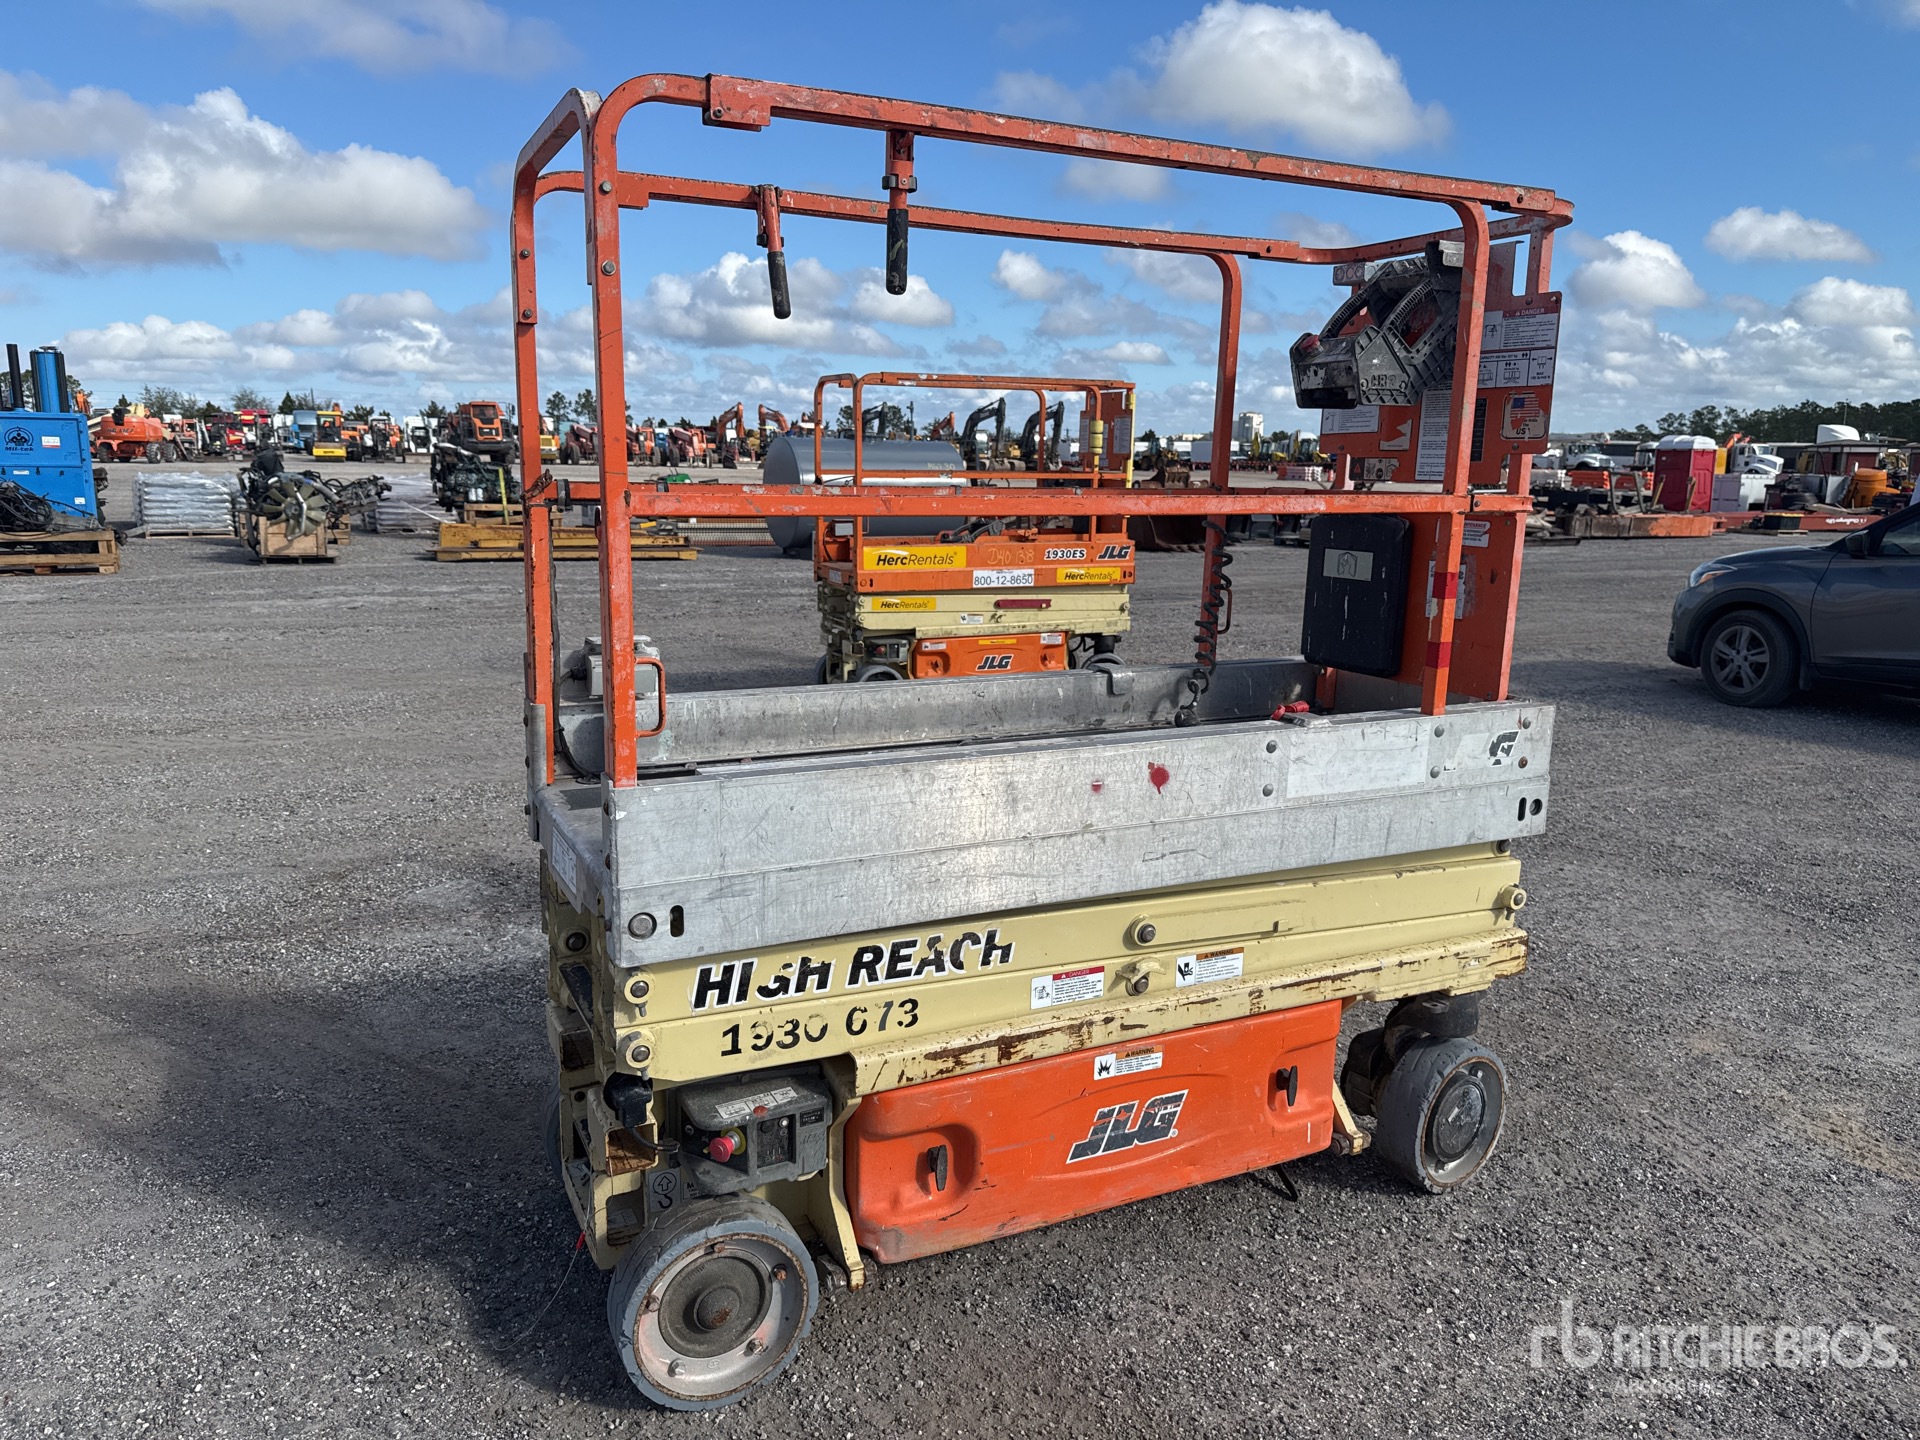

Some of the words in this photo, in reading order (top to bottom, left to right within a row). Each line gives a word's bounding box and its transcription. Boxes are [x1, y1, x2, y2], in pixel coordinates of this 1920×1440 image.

[1521, 308, 1545, 316] DANGER
[1045, 548, 1087, 560] 1930ES
[1098, 545, 1132, 560] JLG
[876, 553, 954, 566] HercRentals
[974, 573, 1033, 586] 800-12-8650
[1064, 571, 1113, 581] HercRentals
[880, 601, 928, 609] HercRentals
[976, 654, 1013, 671] JLG
[693, 956, 835, 1011] HIGH
[846, 929, 1015, 987] REACH
[1068, 969, 1090, 978] DANGER
[1130, 1046, 1155, 1057] WARNING
[1066, 1089, 1188, 1164] JLG
